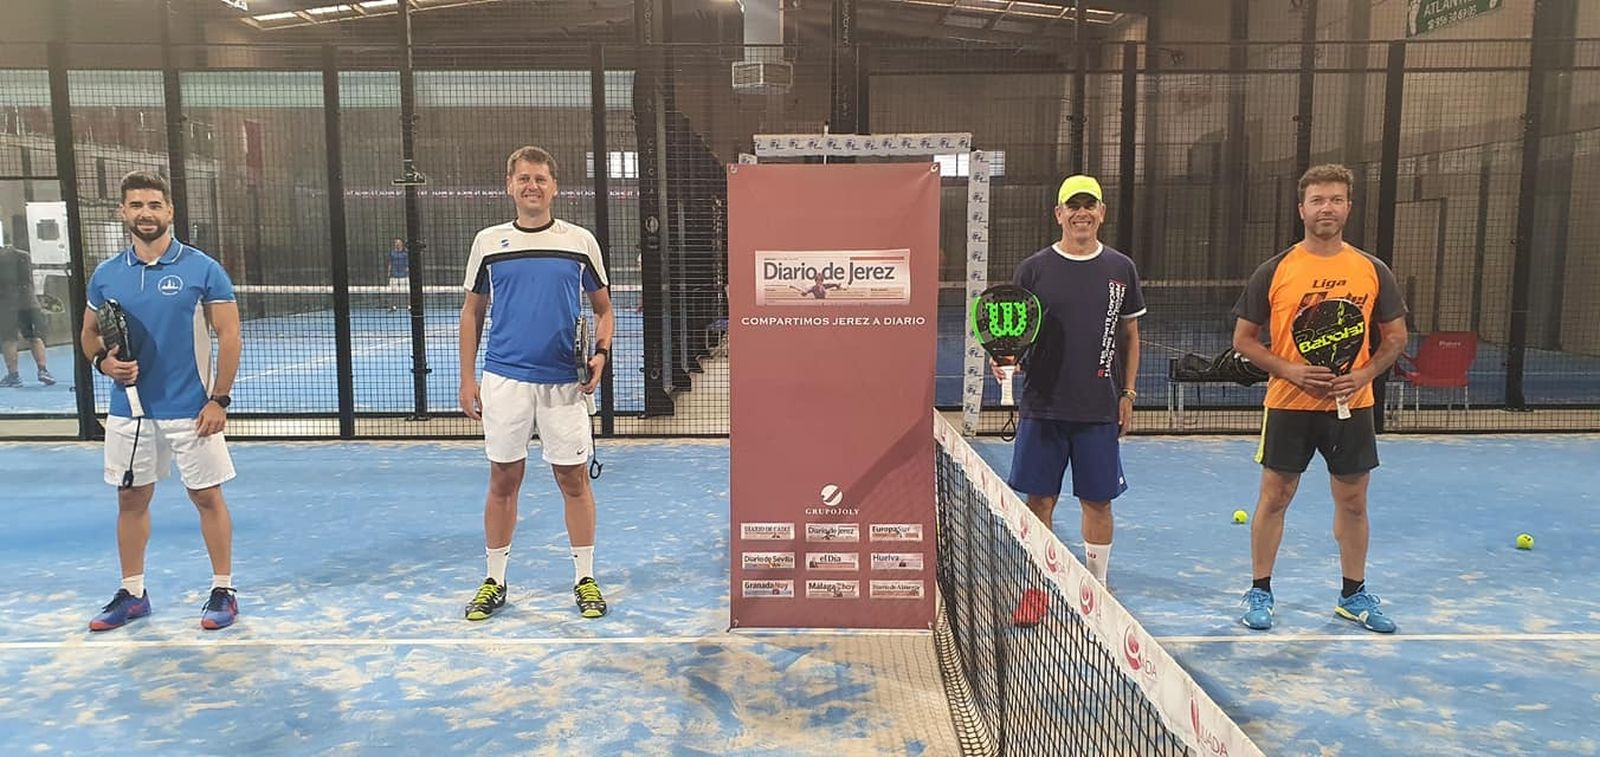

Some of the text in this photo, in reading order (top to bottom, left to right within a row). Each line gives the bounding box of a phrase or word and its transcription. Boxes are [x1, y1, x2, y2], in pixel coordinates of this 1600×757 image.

[763, 261, 896, 285] Diario de Jerez
[1312, 278, 1347, 289] Liga
[741, 316, 926, 326] COMPARTIMOS JEREZ A DIARIO
[744, 555, 764, 563] Diario
